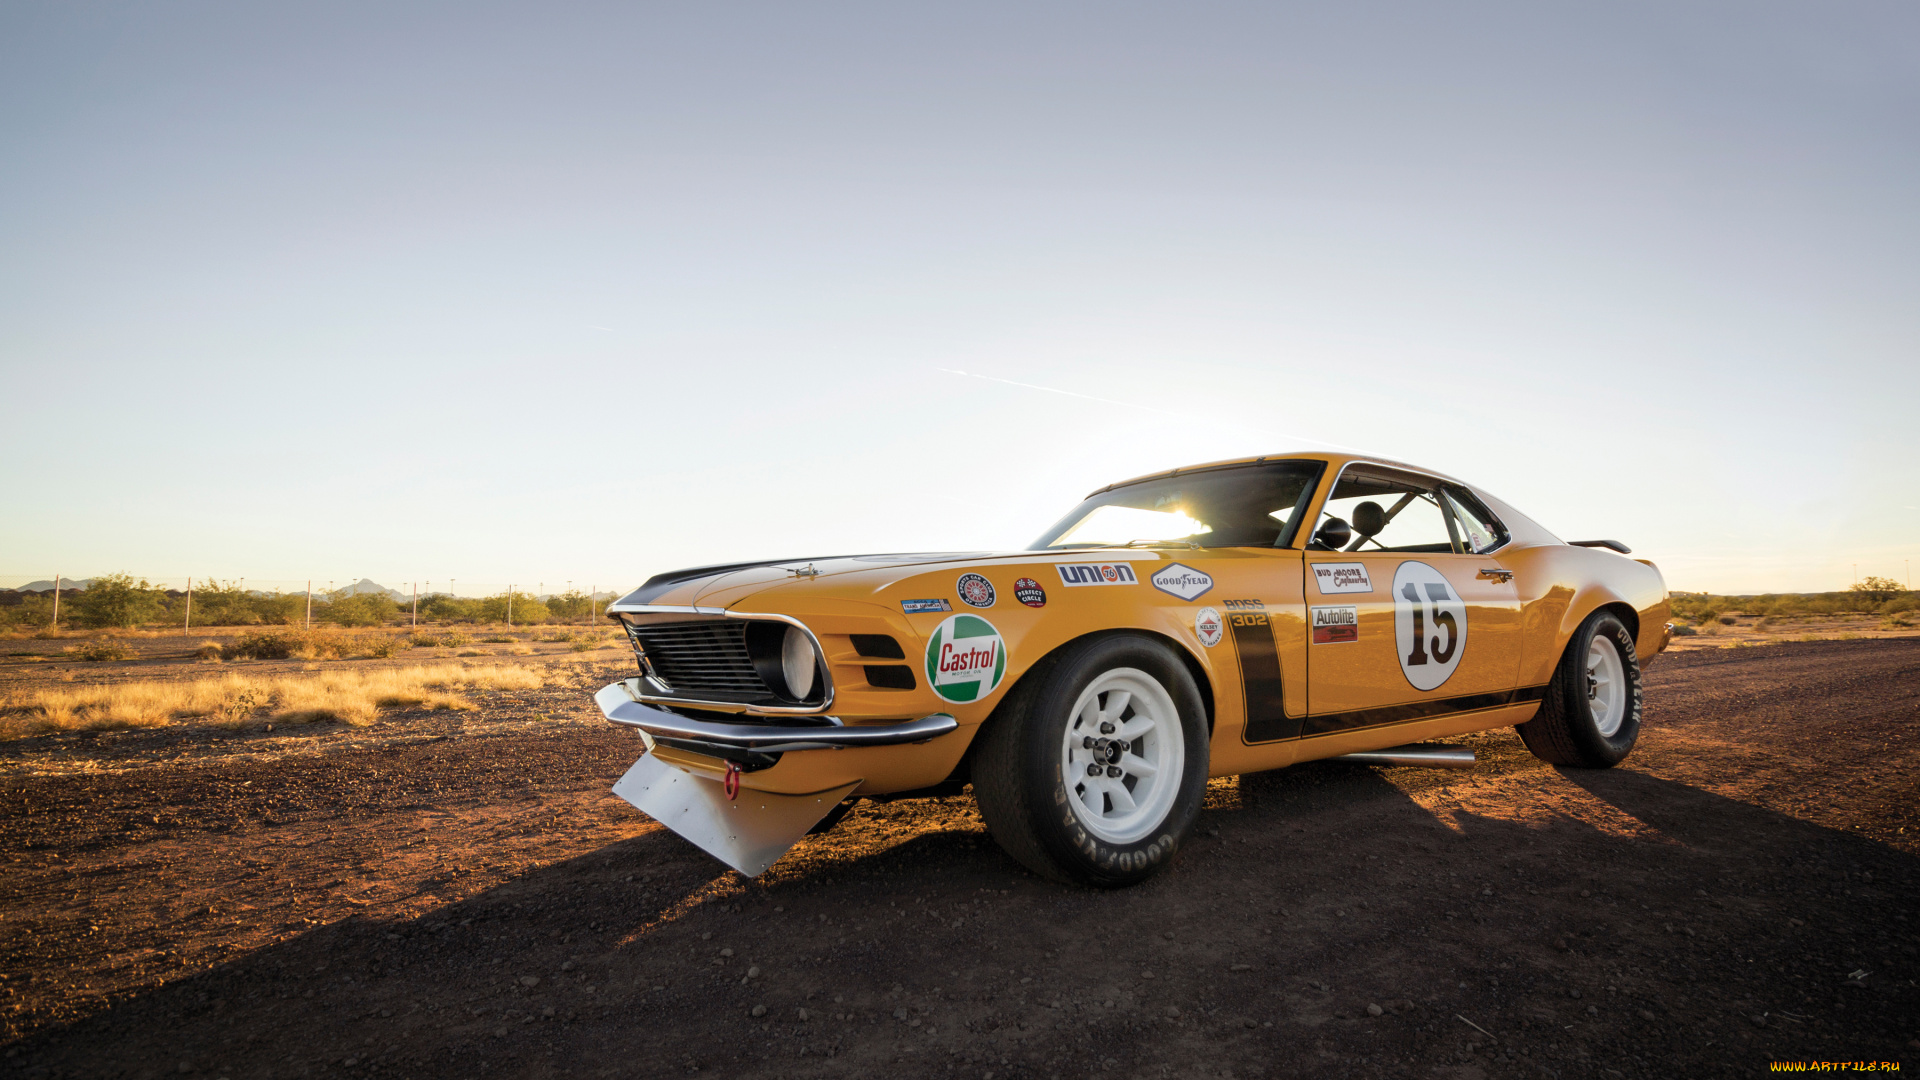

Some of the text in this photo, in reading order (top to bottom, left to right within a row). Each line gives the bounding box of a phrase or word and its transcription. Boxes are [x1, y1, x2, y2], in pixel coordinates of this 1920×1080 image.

[1105, 568, 1115, 579] 76
[1316, 568, 1361, 577] BUD MOORE
[959, 576, 970, 594] SPORTS
[982, 580, 993, 594] CLUB
[1017, 589, 1042, 597] PERFECT
[1223, 599, 1265, 610] BOSS
[1231, 614, 1268, 627] 302
[1316, 608, 1354, 625] Autolite
[1401, 582, 1458, 666] 15
[940, 640, 996, 673] Castrol
